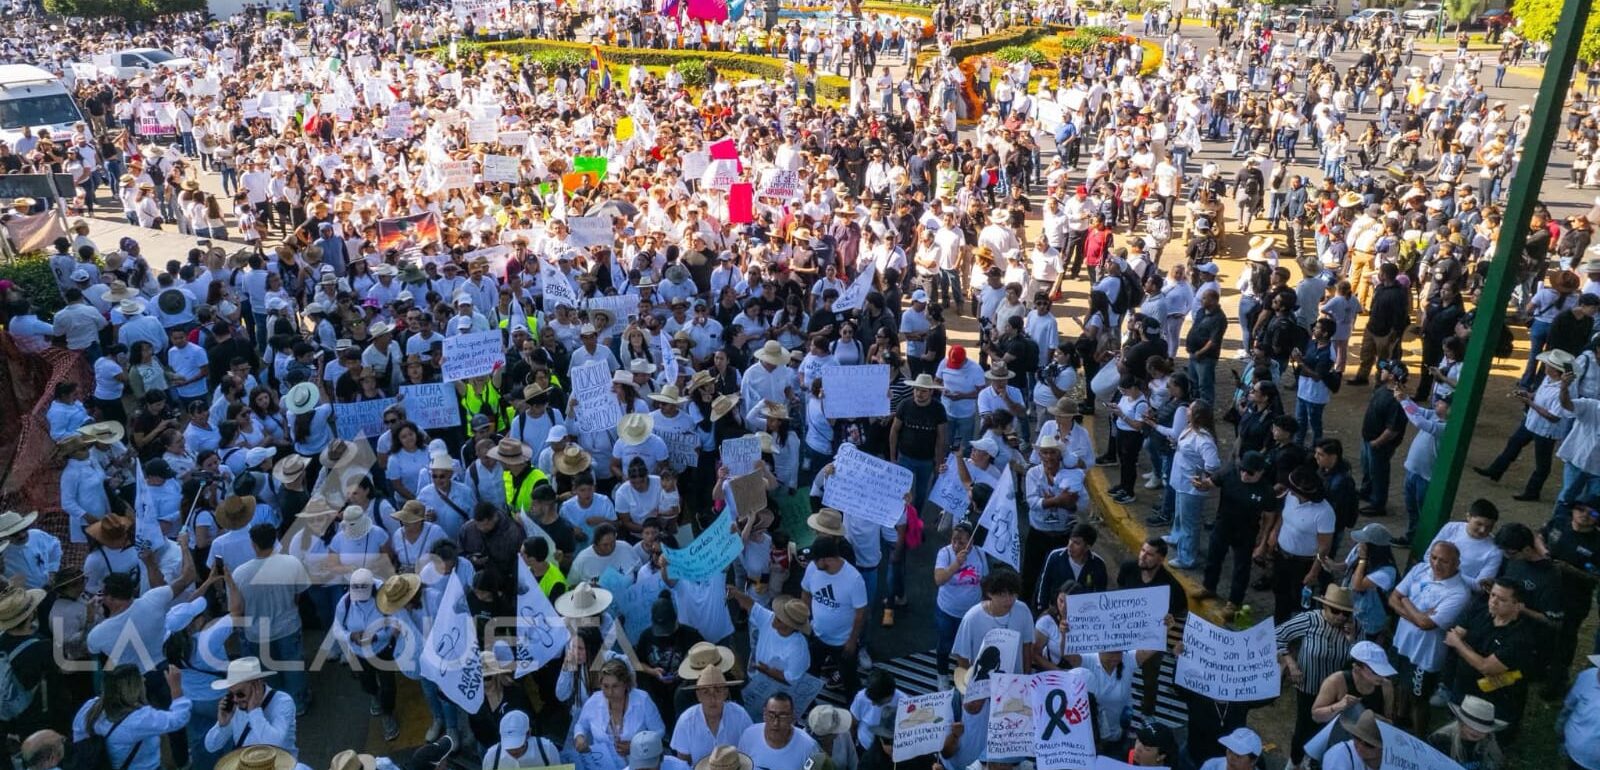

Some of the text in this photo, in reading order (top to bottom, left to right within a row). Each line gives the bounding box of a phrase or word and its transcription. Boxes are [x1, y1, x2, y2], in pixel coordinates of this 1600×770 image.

[415, 383, 442, 398] LUCHA
[812, 591, 841, 609] adidas
[1099, 593, 1148, 611] Queremos
[1111, 621, 1121, 630] la
[1067, 631, 1099, 643] noches
[1223, 650, 1240, 660] son
[1247, 648, 1256, 660] la
[1220, 672, 1258, 687] Uruapan
[1412, 667, 1424, 697] adida
[1217, 685, 1229, 697] la
[1235, 685, 1258, 699] pena
